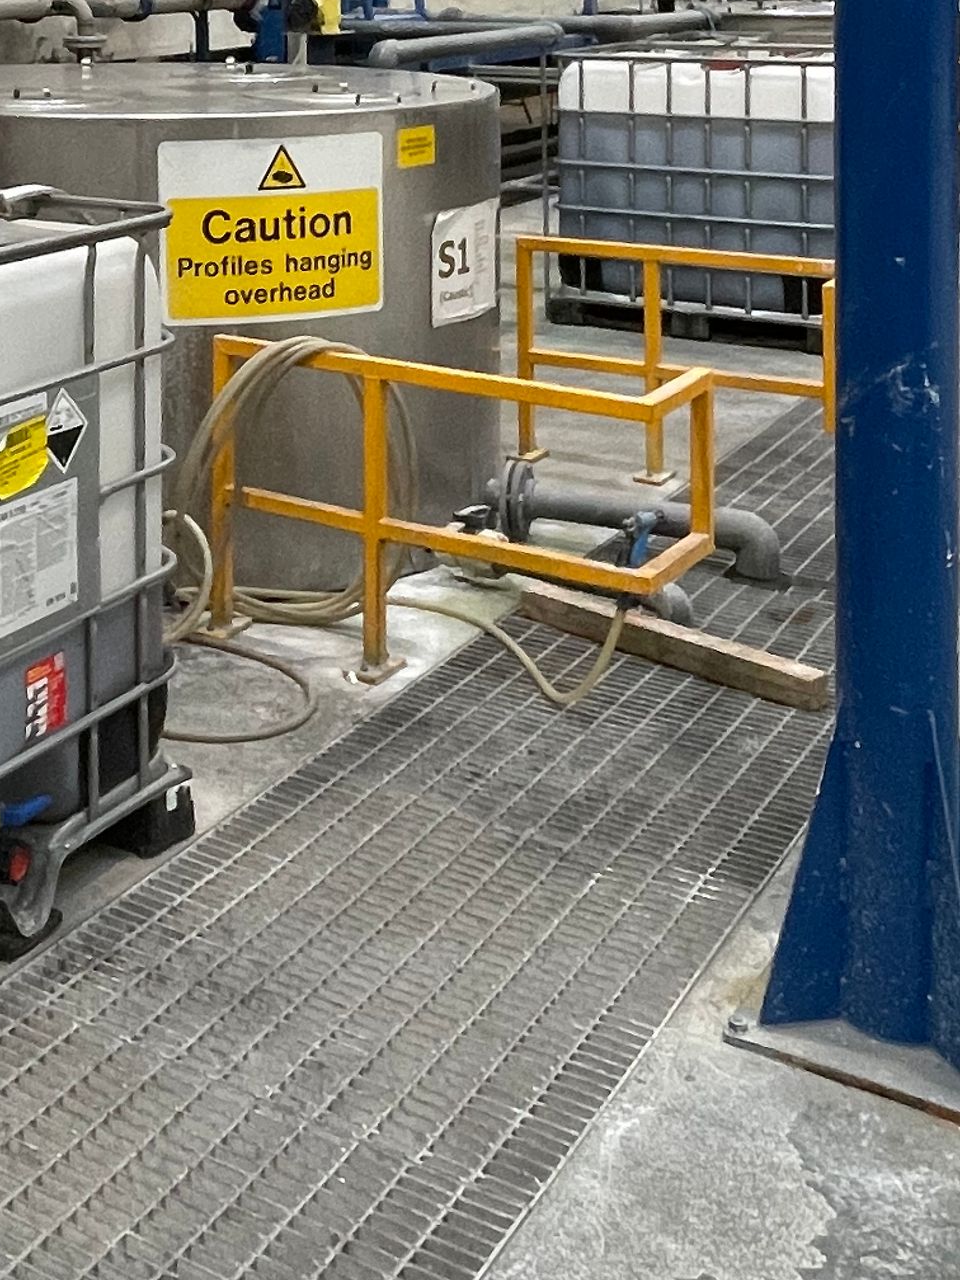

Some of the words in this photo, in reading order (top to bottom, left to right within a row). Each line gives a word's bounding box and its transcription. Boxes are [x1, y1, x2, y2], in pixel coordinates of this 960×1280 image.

[201, 206, 352, 245] Caution
[177, 254, 273, 279] Profiles
[285, 247, 373, 276] hanging
[438, 236, 470, 280] S1
[224, 278, 336, 307] overhead
